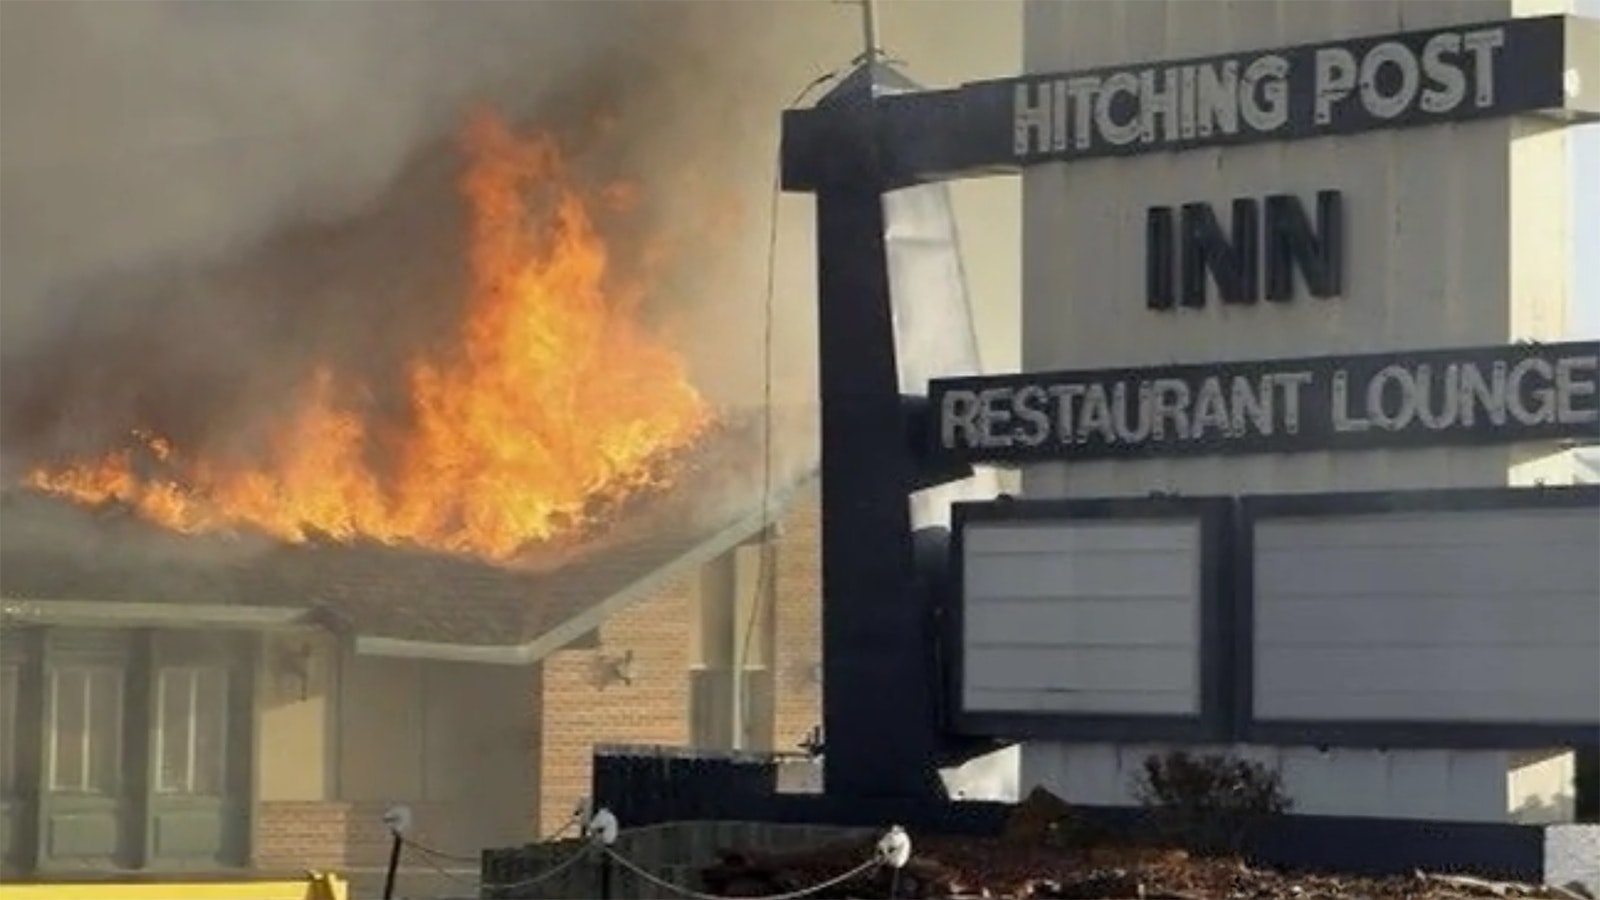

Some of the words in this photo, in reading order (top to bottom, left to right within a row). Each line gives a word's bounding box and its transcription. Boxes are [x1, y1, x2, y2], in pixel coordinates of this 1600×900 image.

[1013, 54, 1290, 156] HITCHING
[1314, 29, 1504, 125] POST
[1146, 189, 1343, 311] INN
[941, 372, 1312, 449] RESTAURANT
[1332, 356, 1599, 432] LOUNGE
